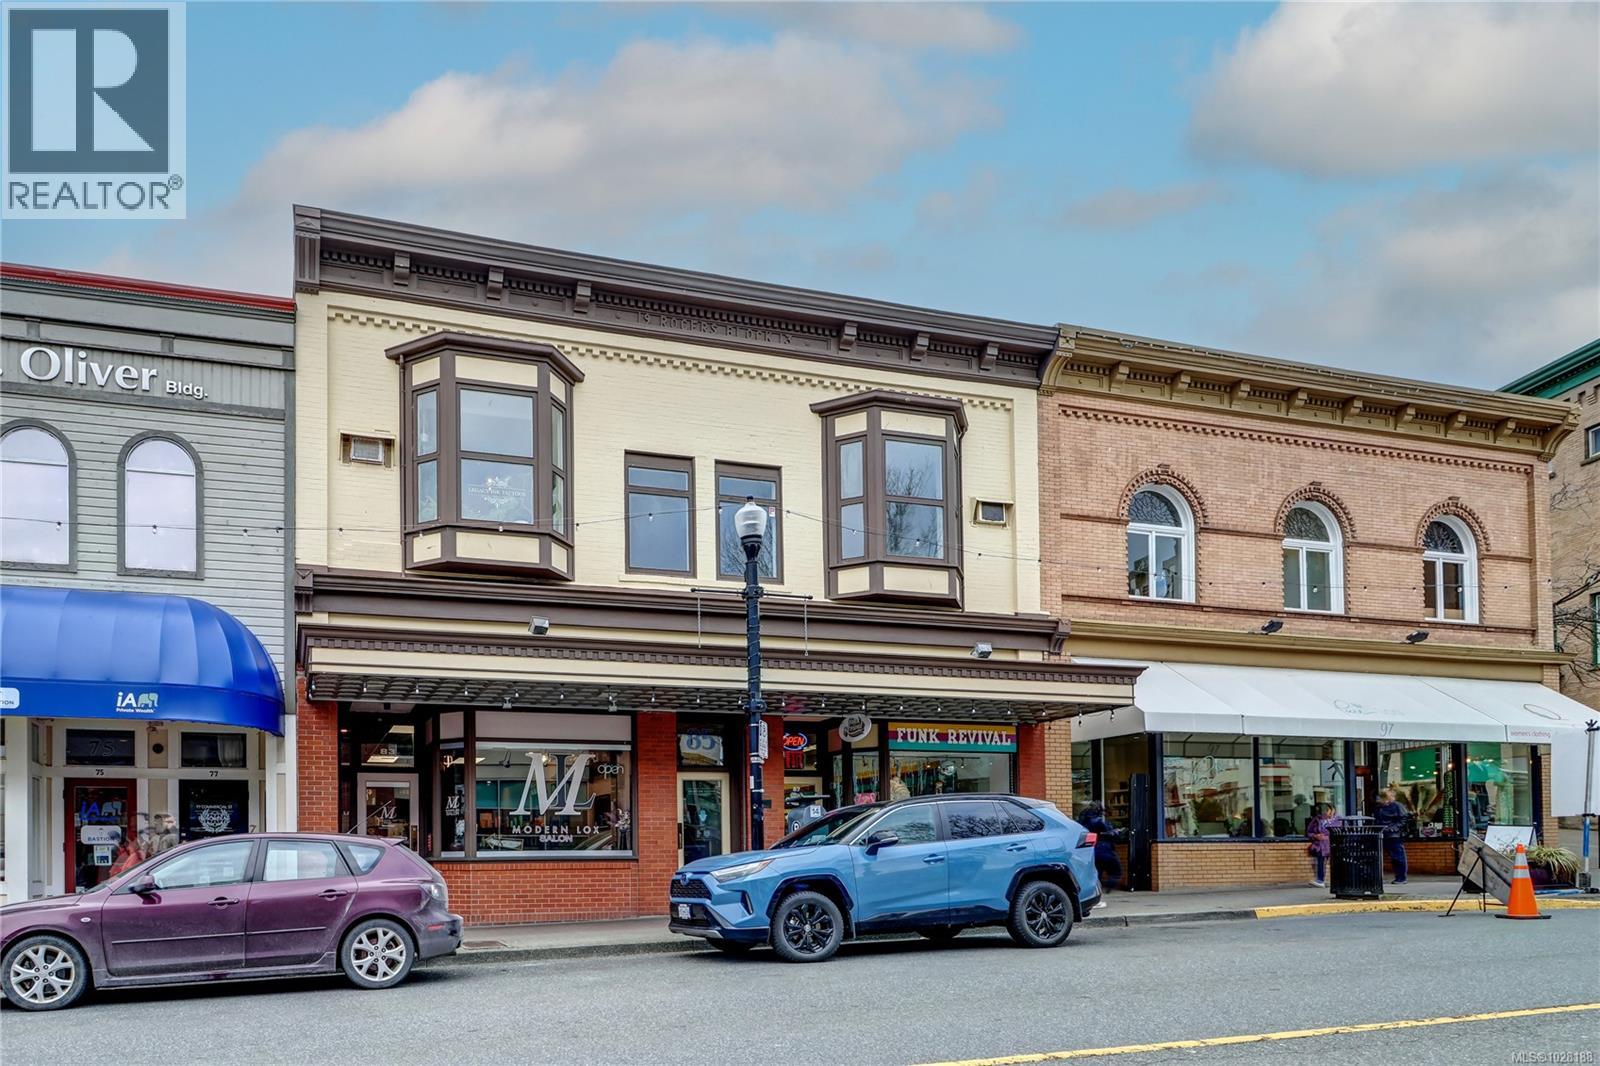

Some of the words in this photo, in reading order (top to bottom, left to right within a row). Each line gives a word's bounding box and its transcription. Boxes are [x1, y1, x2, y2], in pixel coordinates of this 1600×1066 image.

[659, 314, 718, 335] ROGERS
[724, 324, 772, 343] BLOCK
[20, 346, 159, 391] Oliver
[165, 379, 209, 400] Bldg.
[116, 691, 137, 707] iA
[1380, 721, 1394, 736] 97
[783, 736, 805, 746] OPEN
[896, 727, 940, 744] FUNK
[947, 729, 1011, 746] REVIVAL
[95, 768, 105, 776] 75
[209, 770, 219, 778] 77
[597, 764, 624, 779] open
[512, 825, 569, 834] MODERN
[576, 826, 600, 834] LOX
[539, 834, 573, 843] SALON
